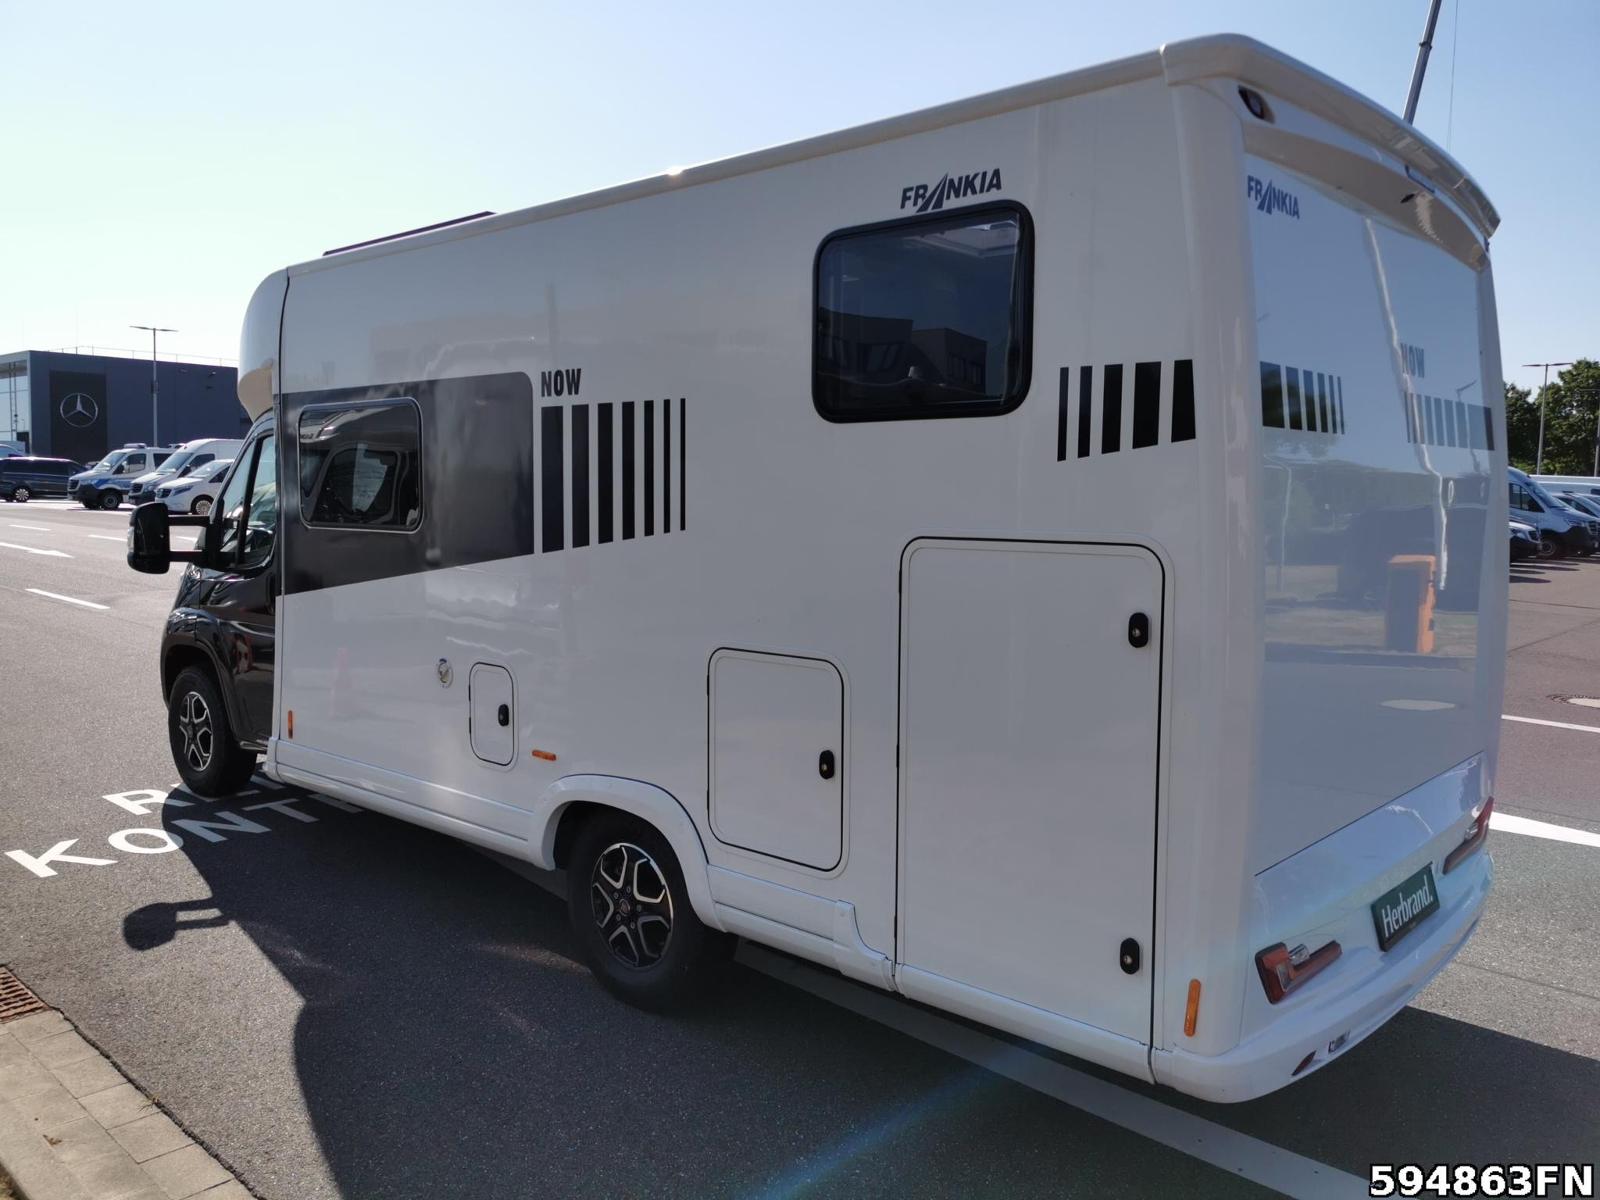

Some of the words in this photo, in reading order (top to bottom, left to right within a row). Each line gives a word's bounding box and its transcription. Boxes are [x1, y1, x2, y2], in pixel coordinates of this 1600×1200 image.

[900, 168, 1002, 213] FRANKIA
[1247, 174, 1300, 219] FRANKIA
[541, 368, 581, 397] NOW
